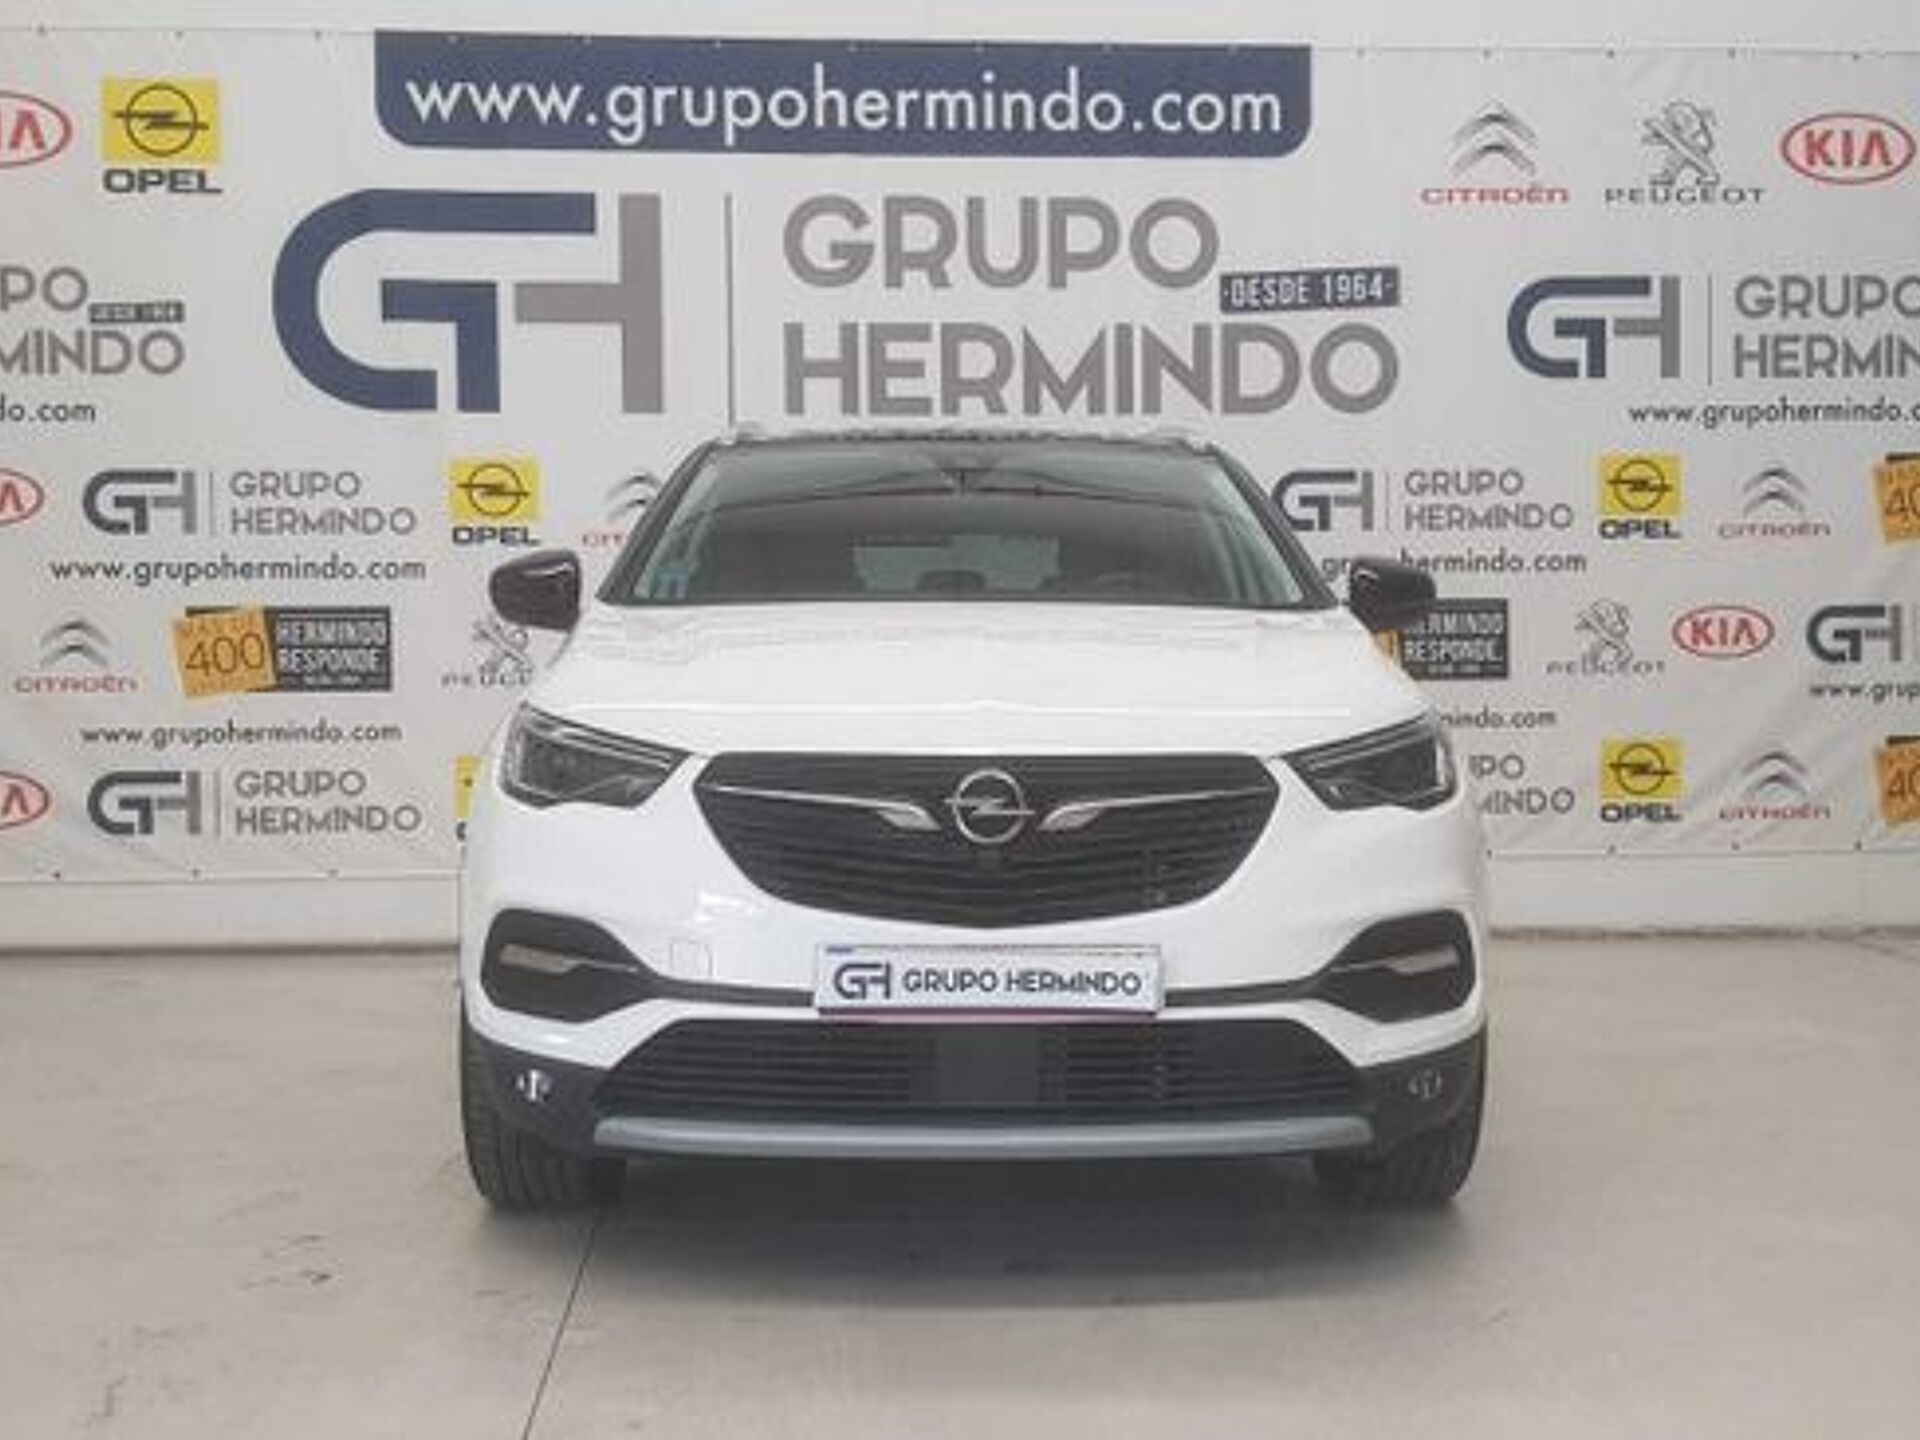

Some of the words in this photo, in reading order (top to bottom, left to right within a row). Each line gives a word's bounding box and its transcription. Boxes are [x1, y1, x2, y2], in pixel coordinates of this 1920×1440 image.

[405, 62, 1281, 146] www.grupohermindo.com
[1804, 129, 1894, 167] KIA
[103, 169, 222, 193] OPEL
[1605, 188, 1765, 204] PEUGEOT
[783, 196, 1220, 289] GRUPO
[783, 323, 1399, 416] HERMINDO
[230, 472, 361, 499] GRUPO
[1404, 469, 1524, 496] GRUPO
[231, 507, 417, 536] HERMINDO
[1405, 503, 1574, 531] HERMINDO
[1600, 520, 1681, 539] OPEL
[453, 526, 541, 545] OPEL
[50, 554, 427, 582] www.grupohermindo.com
[1691, 617, 1756, 646] KIA
[185, 633, 265, 675] 400
[81, 718, 402, 748] www.grupohermindo.com
[235, 770, 366, 797] GRUPO
[236, 805, 421, 834] HERMINDO
[1601, 803, 1682, 822] OPEL
[902, 968, 999, 993] GRUPO
[1006, 967, 1142, 996] HERMINDO
